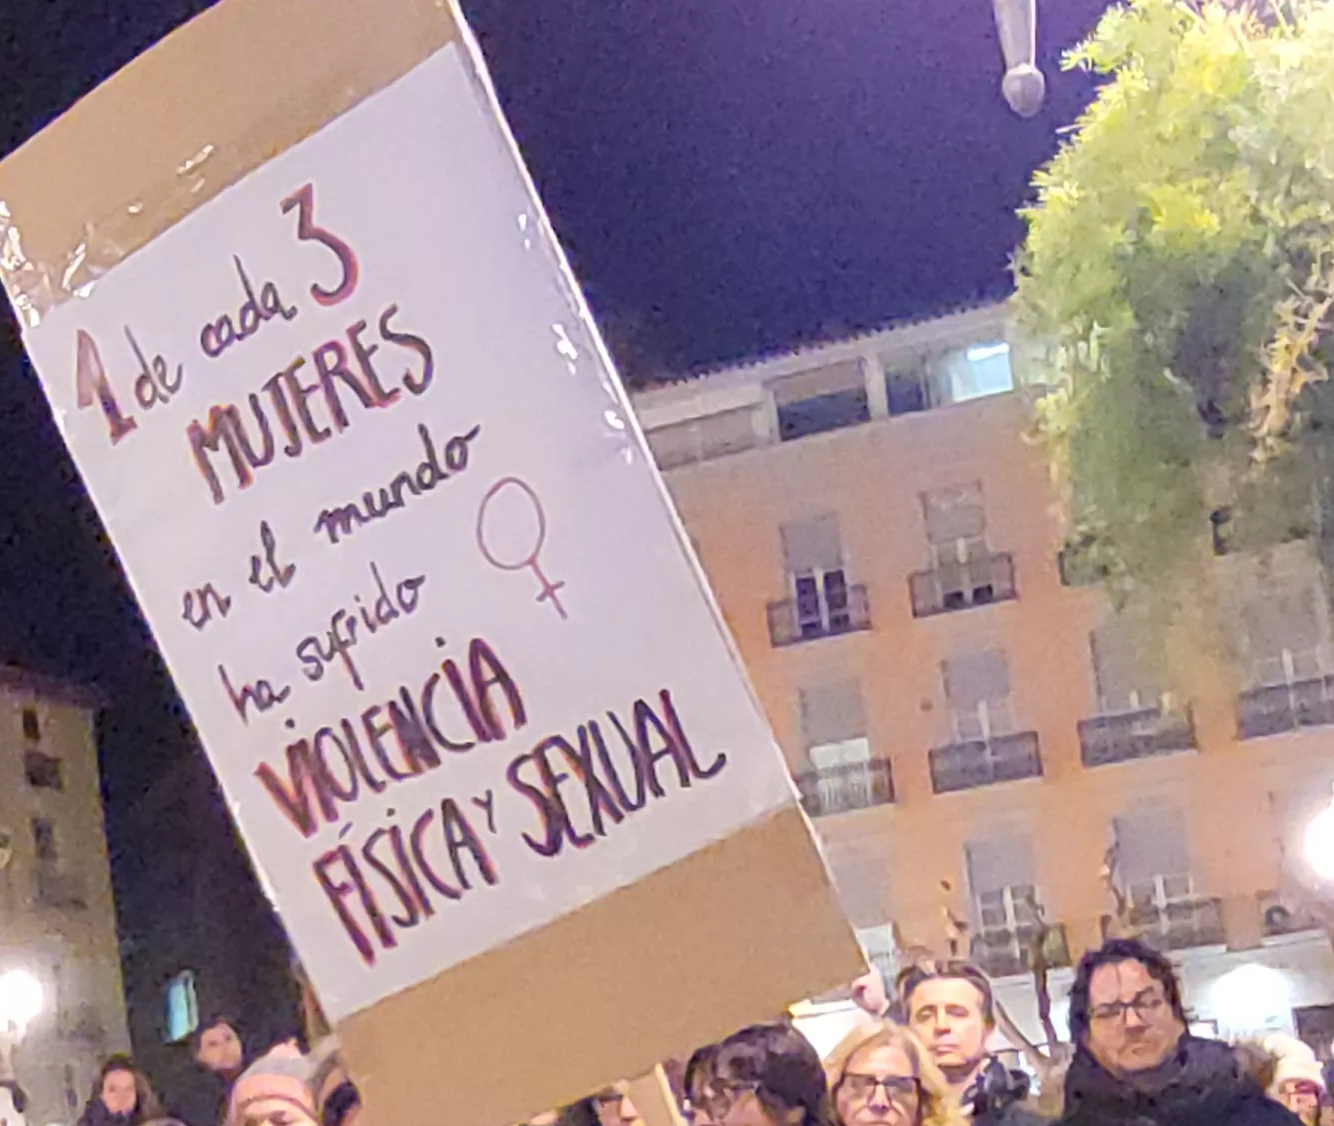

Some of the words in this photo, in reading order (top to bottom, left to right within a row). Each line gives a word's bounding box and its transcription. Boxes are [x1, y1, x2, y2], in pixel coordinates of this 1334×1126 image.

[75, 328, 139, 447] 1
[123, 324, 184, 410] de
[199, 253, 298, 358] cada
[279, 182, 359, 307] 3
[186, 303, 434, 506] MUJERES
[181, 581, 232, 633] en
[247, 519, 297, 594] el
[312, 422, 482, 545] mundo
[217, 663, 292, 727] ha
[295, 560, 427, 692] sufrido
[252, 635, 529, 839] VIOLENCIA
[311, 796, 499, 968] FÍSICA
[505, 687, 728, 859] SEXUAL
